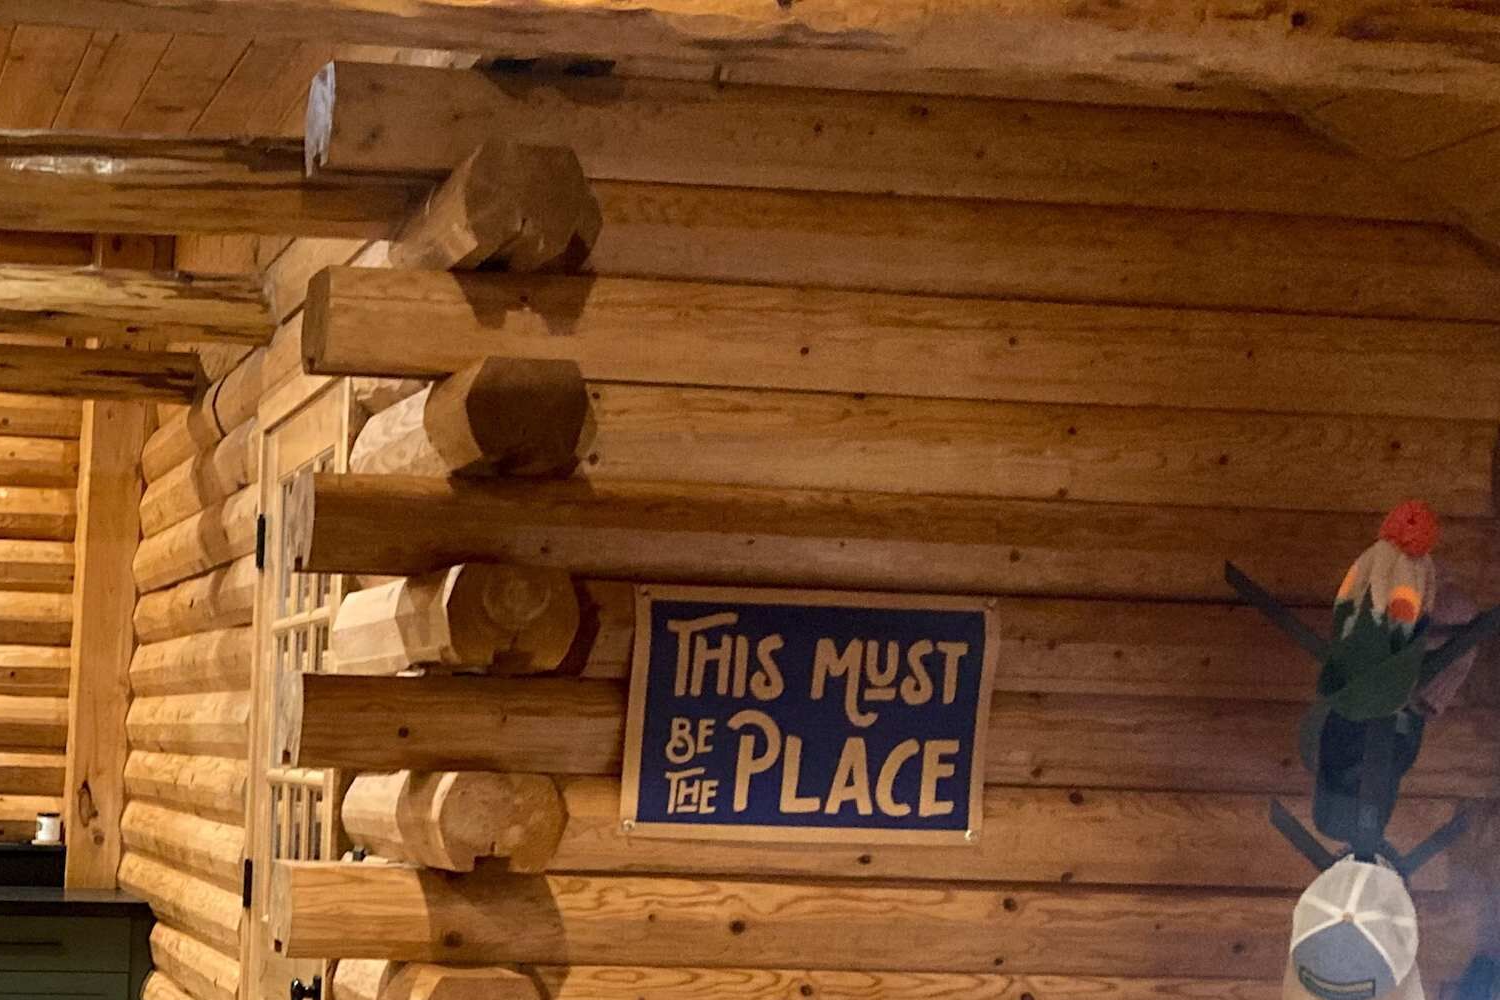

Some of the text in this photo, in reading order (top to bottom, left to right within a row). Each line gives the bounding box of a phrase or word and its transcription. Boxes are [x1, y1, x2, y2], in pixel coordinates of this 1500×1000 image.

[667, 612, 968, 727] THIS MUST
[665, 717, 716, 764] BE
[727, 709, 960, 817] PLACE
[665, 767, 719, 815] THE
